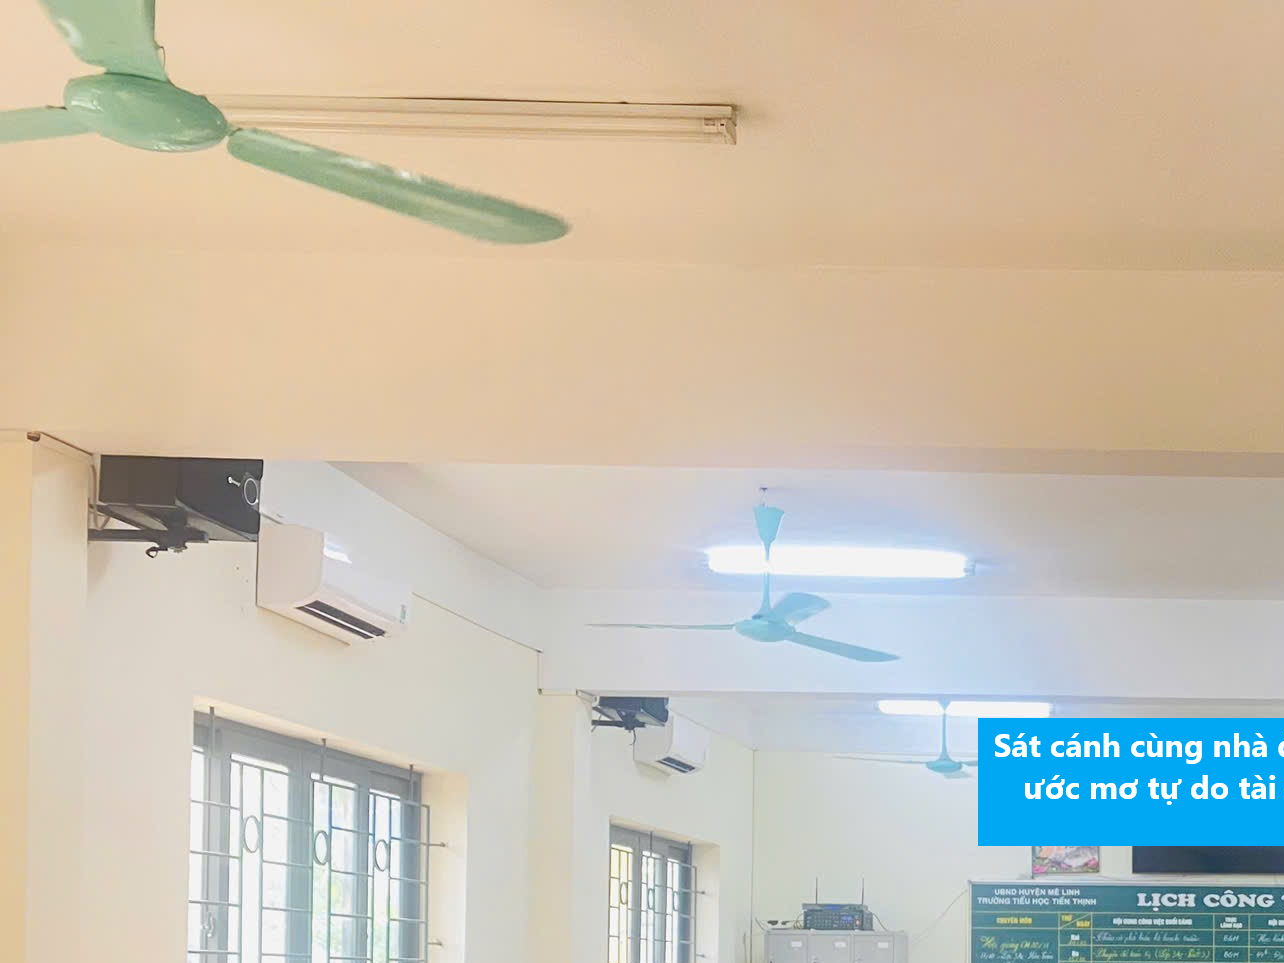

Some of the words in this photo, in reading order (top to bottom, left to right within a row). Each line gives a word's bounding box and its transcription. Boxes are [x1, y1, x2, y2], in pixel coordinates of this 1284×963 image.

[994, 888, 1017, 896] UBND
[1018, 887, 1046, 898] HUYỆN
[1047, 887, 1060, 896] MÊ
[1061, 888, 1080, 896] LINH
[977, 896, 1011, 905] TRƯỜNG
[1012, 896, 1031, 905] TIỂU
[1032, 897, 1050, 907] HỌC
[1052, 896, 1071, 905] TIẾN
[1072, 897, 1097, 907] THỊNH
[1137, 893, 1197, 913] LỊCH
[1203, 889, 1275, 909] CÔNG
